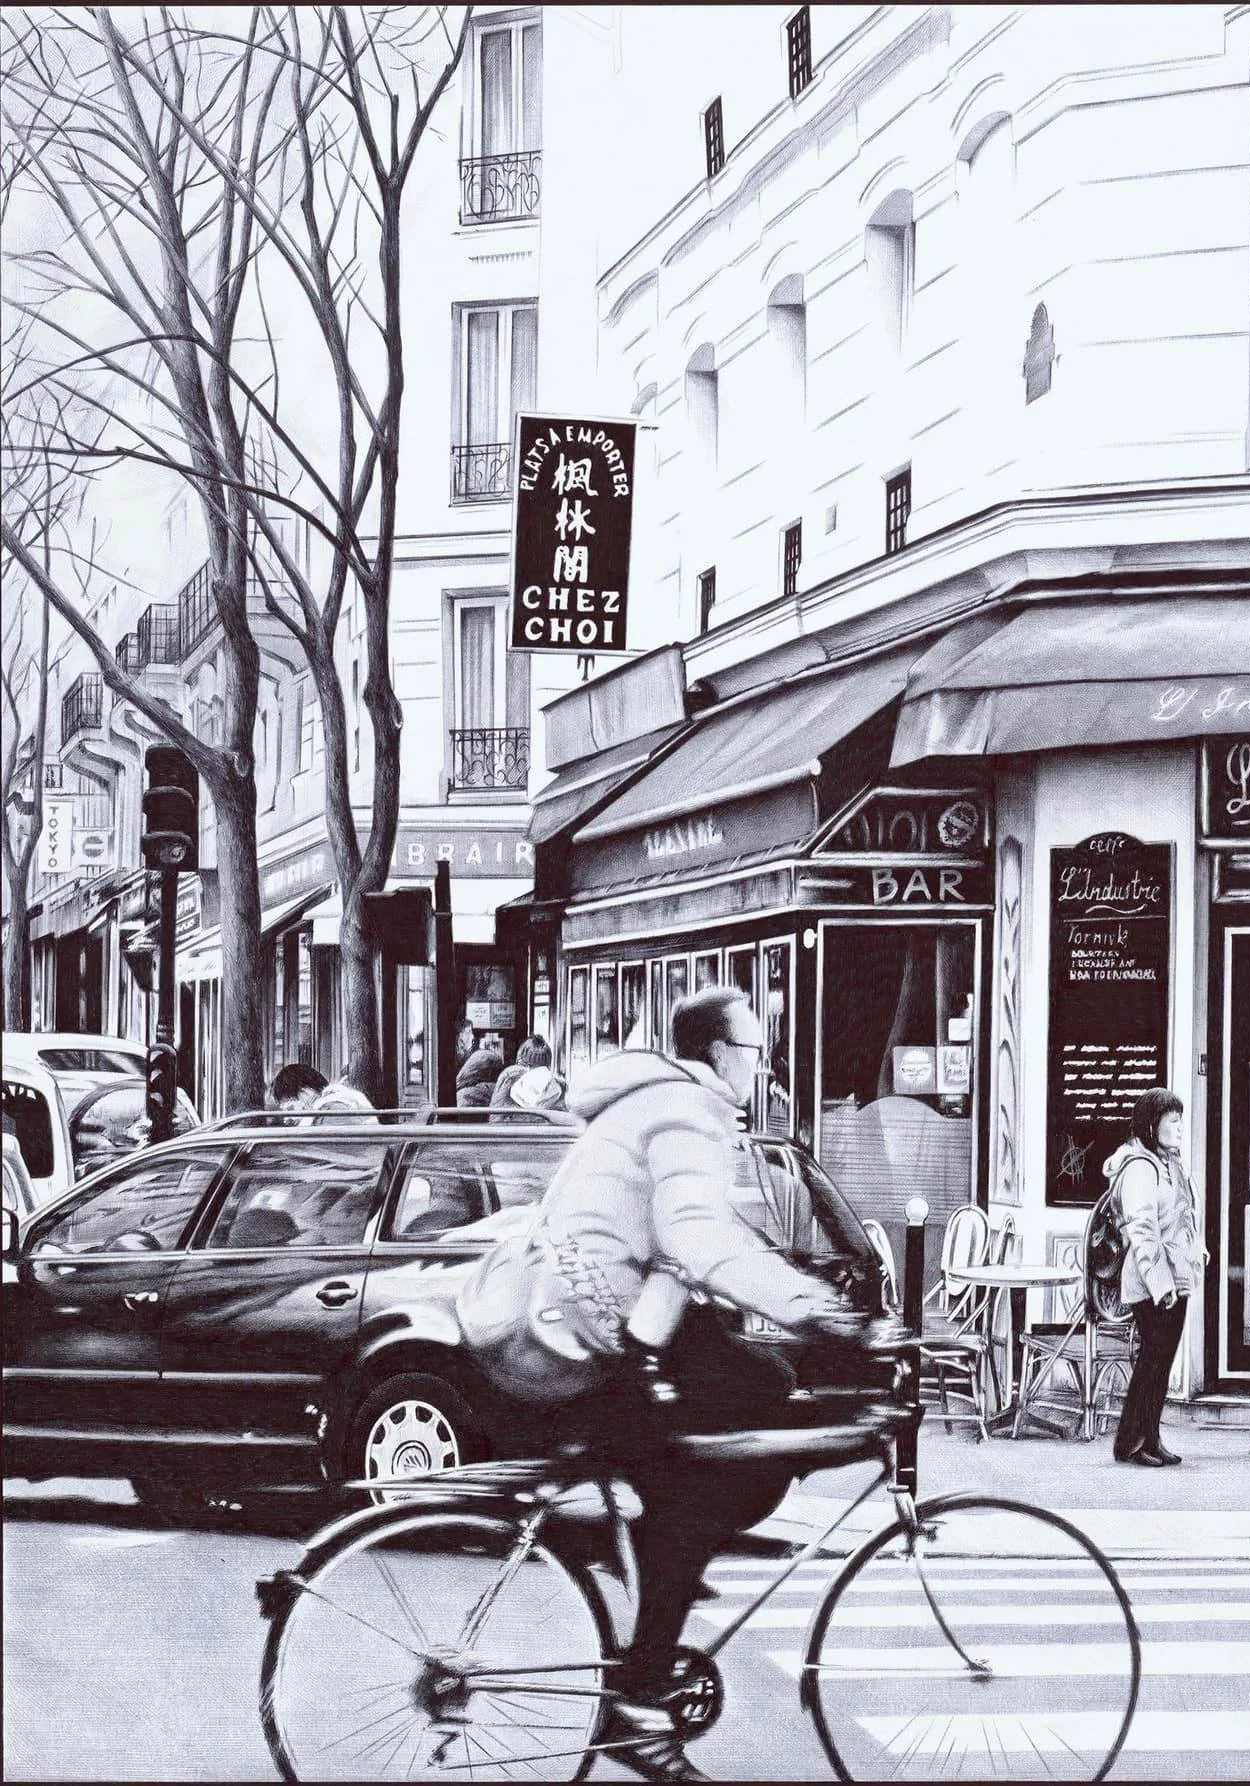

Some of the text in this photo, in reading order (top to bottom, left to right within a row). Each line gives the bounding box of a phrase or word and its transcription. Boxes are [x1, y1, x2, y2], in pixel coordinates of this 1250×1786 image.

[519, 438, 550, 491] PLATS
[565, 425, 630, 499] EMPORTER
[522, 585, 620, 614] CHEZ
[524, 616, 614, 645] CHOI
[48, 805, 59, 869] TOKYO
[871, 867, 966, 905] BAR
